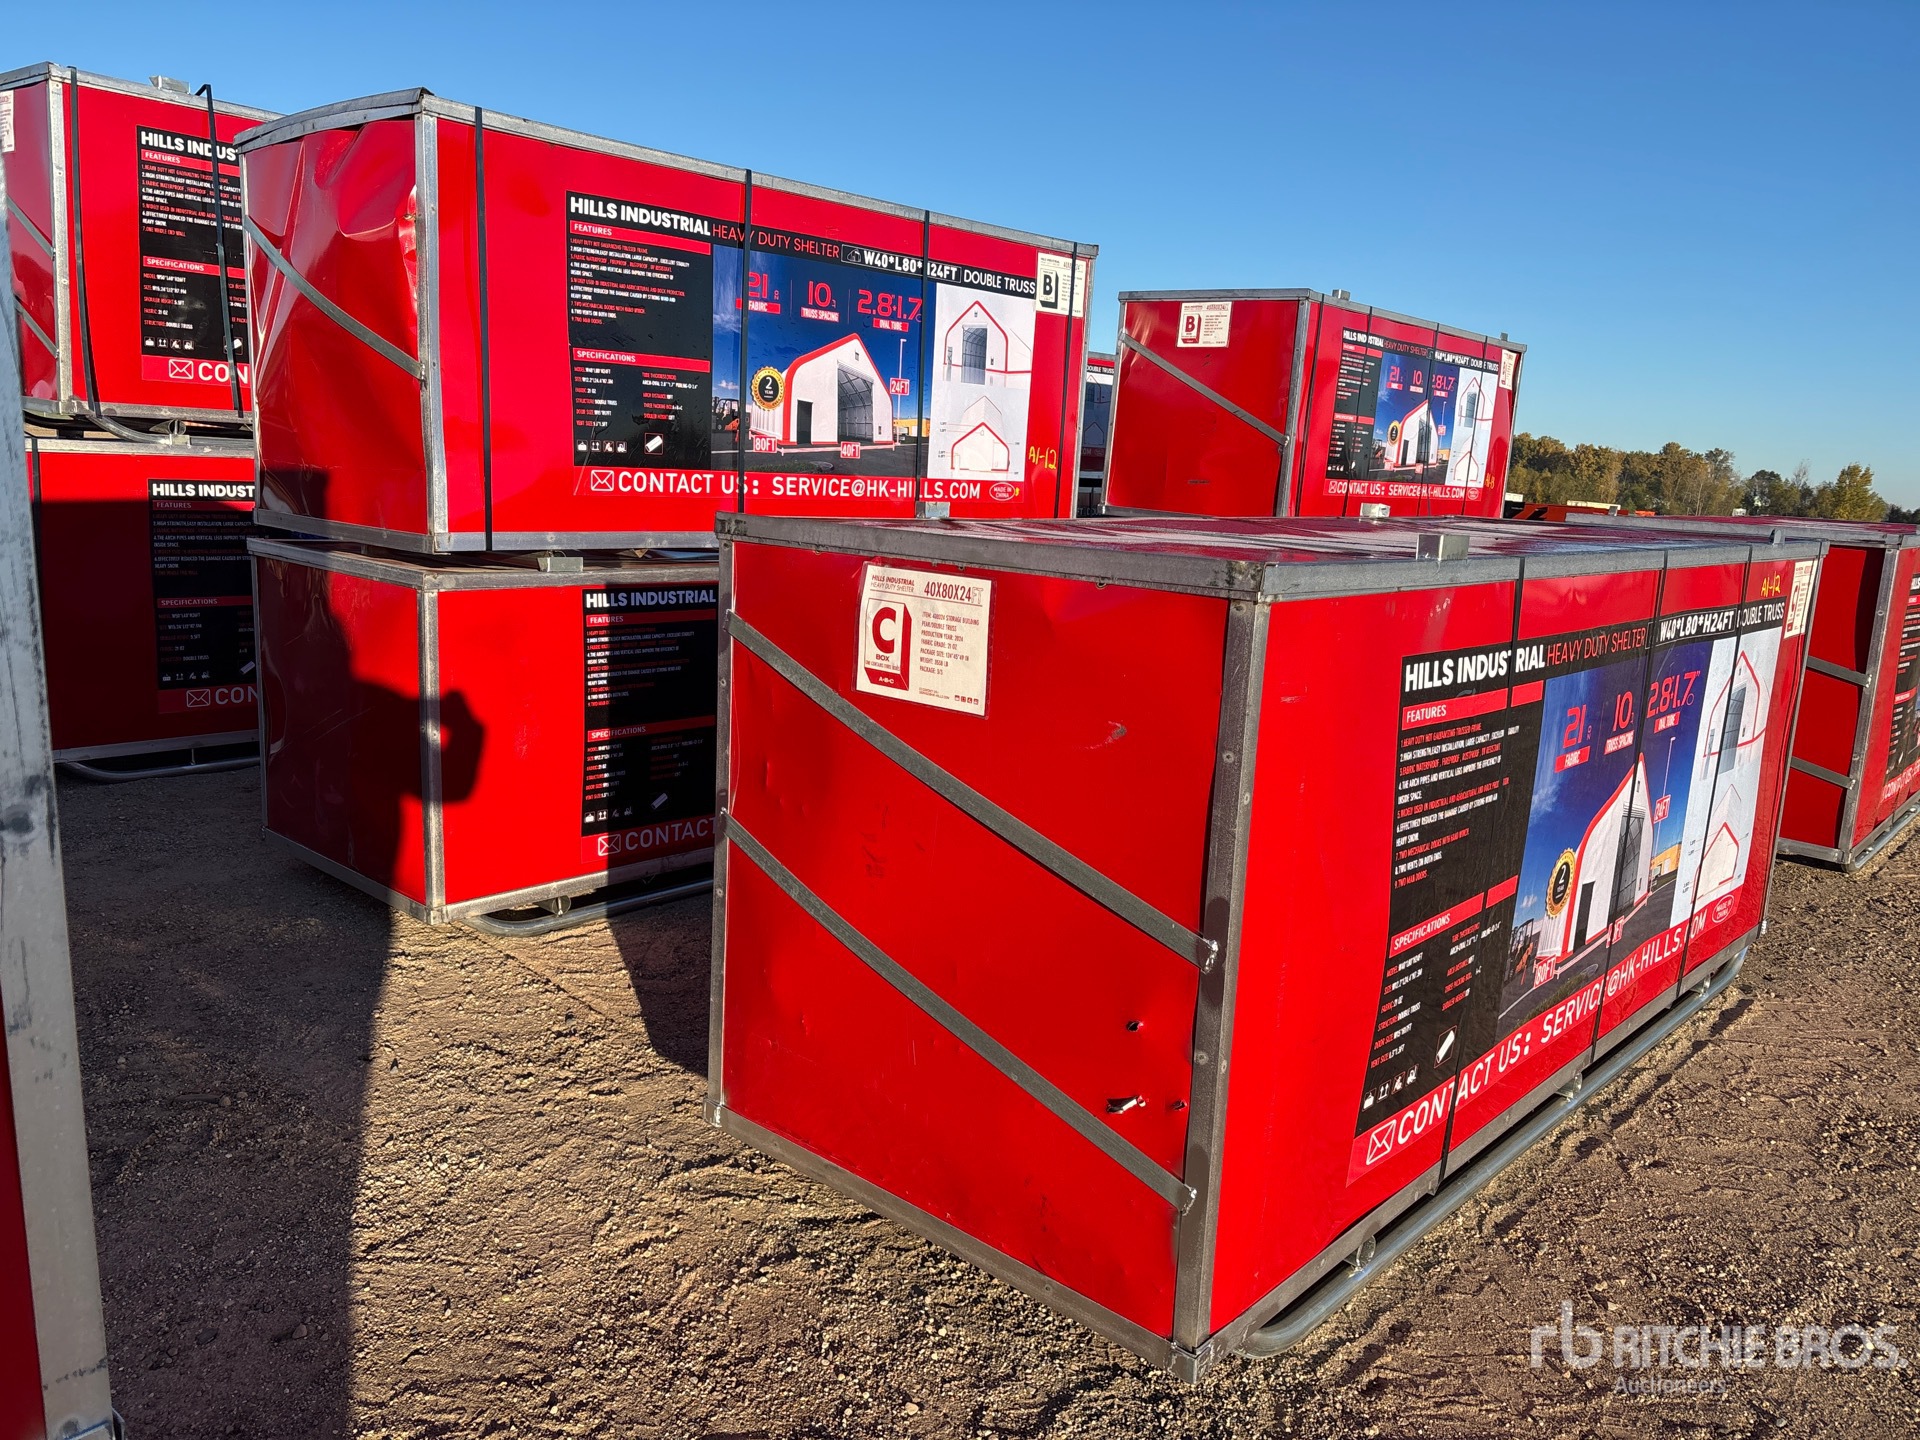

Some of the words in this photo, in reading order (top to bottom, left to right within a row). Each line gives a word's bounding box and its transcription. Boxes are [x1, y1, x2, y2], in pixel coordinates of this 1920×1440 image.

[141, 131, 184, 151] HILLS
[187, 140, 238, 161] INDUS
[145, 152, 181, 163] FEATURES
[574, 223, 612, 236] FEATURES
[571, 197, 617, 219] HILLS
[621, 206, 710, 235] INDUSTRIAL
[758, 232, 791, 249] DUTY
[794, 238, 839, 258] SHELTER
[964, 270, 1001, 289] DOUBLE
[1004, 278, 1035, 295] TRUSS
[147, 258, 204, 271] SPECIFICATIONS
[748, 272, 768, 298] 21
[1043, 274, 1053, 295] B
[808, 281, 831, 307] 10
[1185, 316, 1195, 332] B
[577, 351, 636, 362] SPECIFICATIONS
[1343, 330, 1356, 341] HILLS
[1487, 361, 1499, 371] TRUSS
[1390, 366, 1399, 382] 21
[1413, 370, 1422, 385] 10
[766, 377, 772, 389] 2
[891, 380, 908, 394] 24FT
[755, 437, 776, 452] 80FT
[841, 443, 860, 457] 40FT
[153, 483, 195, 497] HILLS
[618, 471, 713, 493] CONTACT
[721, 474, 758, 495] US:
[1337, 482, 1368, 494] CONTACT
[1370, 484, 1385, 495] US:
[885, 576, 915, 586] INDUSTRIAL
[896, 584, 913, 592] SHELTER
[586, 593, 627, 608] HILLS
[631, 590, 716, 606] INDUSTRIAL
[590, 616, 623, 624] FEATURES
[869, 604, 897, 655] C
[1405, 659, 1453, 692] HILLS
[1457, 644, 1545, 684] INDUSRIAL
[1548, 638, 1582, 666] HEAVY
[1584, 633, 1611, 657] DUTY
[1611, 627, 1647, 651] SHELTER
[1764, 602, 1785, 622] TRUSS
[875, 653, 889, 661] BOX
[1406, 705, 1447, 723] FEATURES
[1613, 691, 1633, 732] 10
[592, 726, 646, 739] SPECIFICATIONS
[1563, 704, 1586, 748] 21
[1655, 797, 1670, 821] 24FT
[1559, 864, 1567, 884] 2
[1394, 914, 1451, 951] SPECIFICATIONS
[1534, 957, 1556, 987] 80FT
[1498, 1031, 1532, 1073] US:
